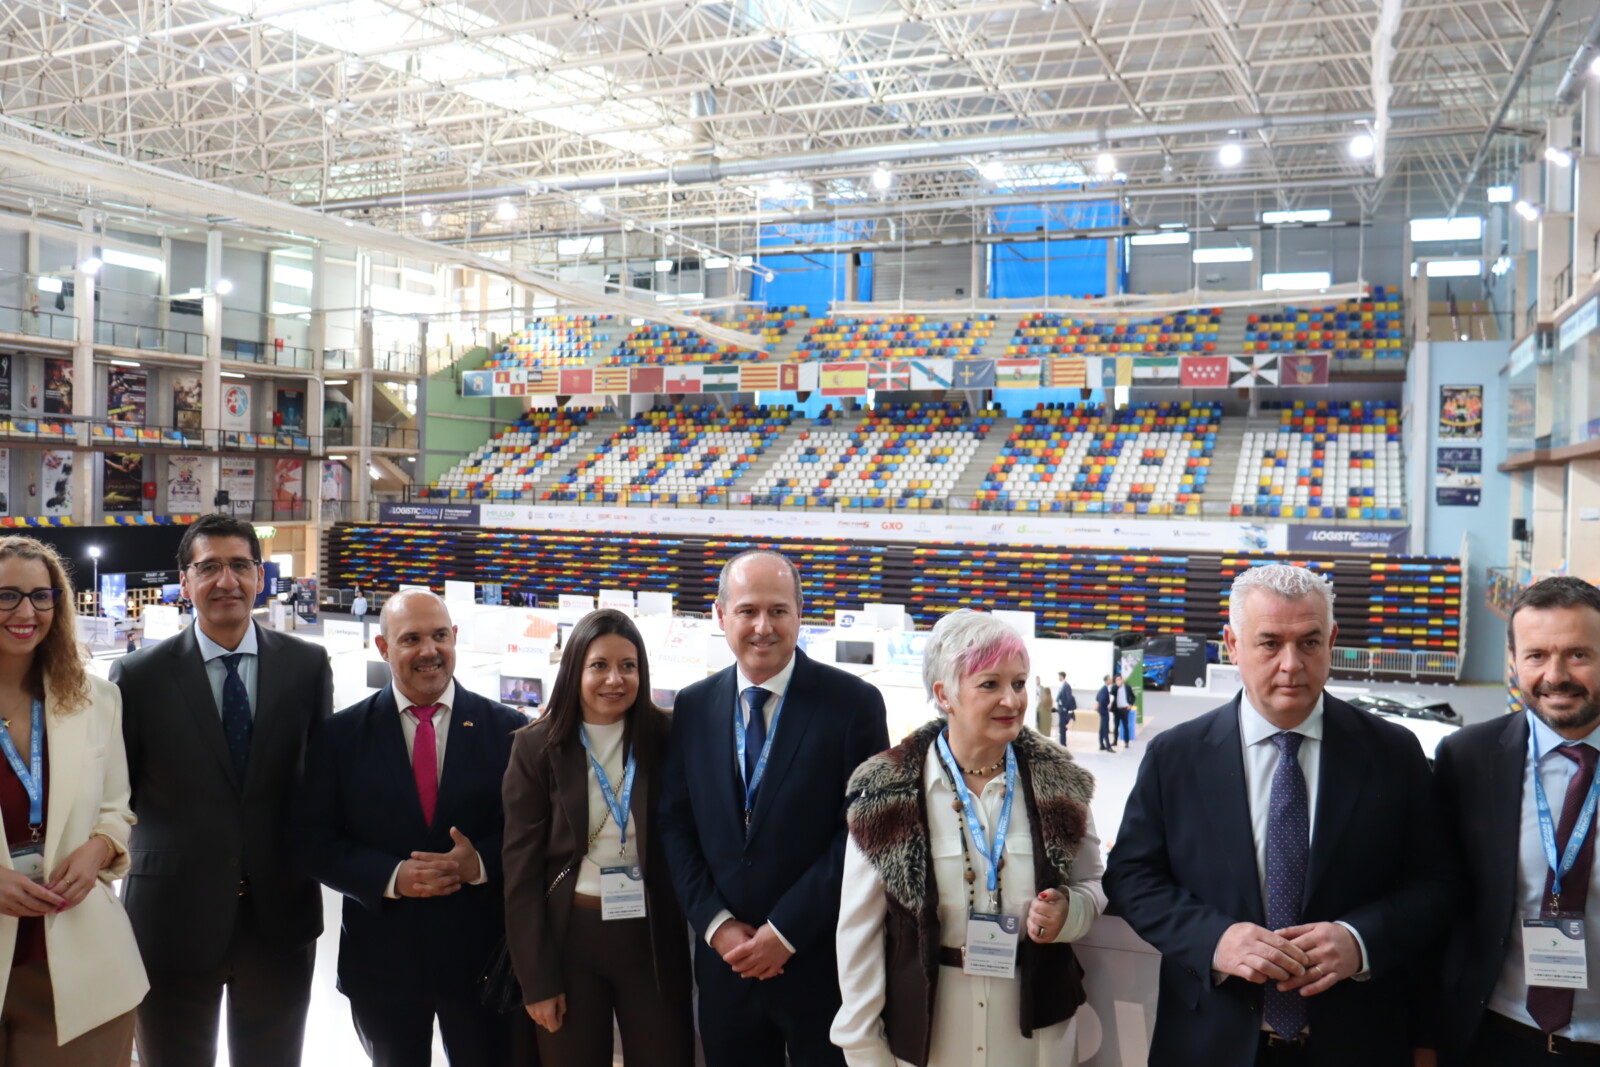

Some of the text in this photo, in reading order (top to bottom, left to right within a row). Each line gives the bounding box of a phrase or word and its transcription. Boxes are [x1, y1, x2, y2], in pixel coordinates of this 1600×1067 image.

[392, 507, 439, 516] LOGISTICSPAIN
[881, 521, 903, 530] GXO
[1312, 530, 1392, 542] LOGISTICSPAIN
[508, 643, 518, 653] FM
